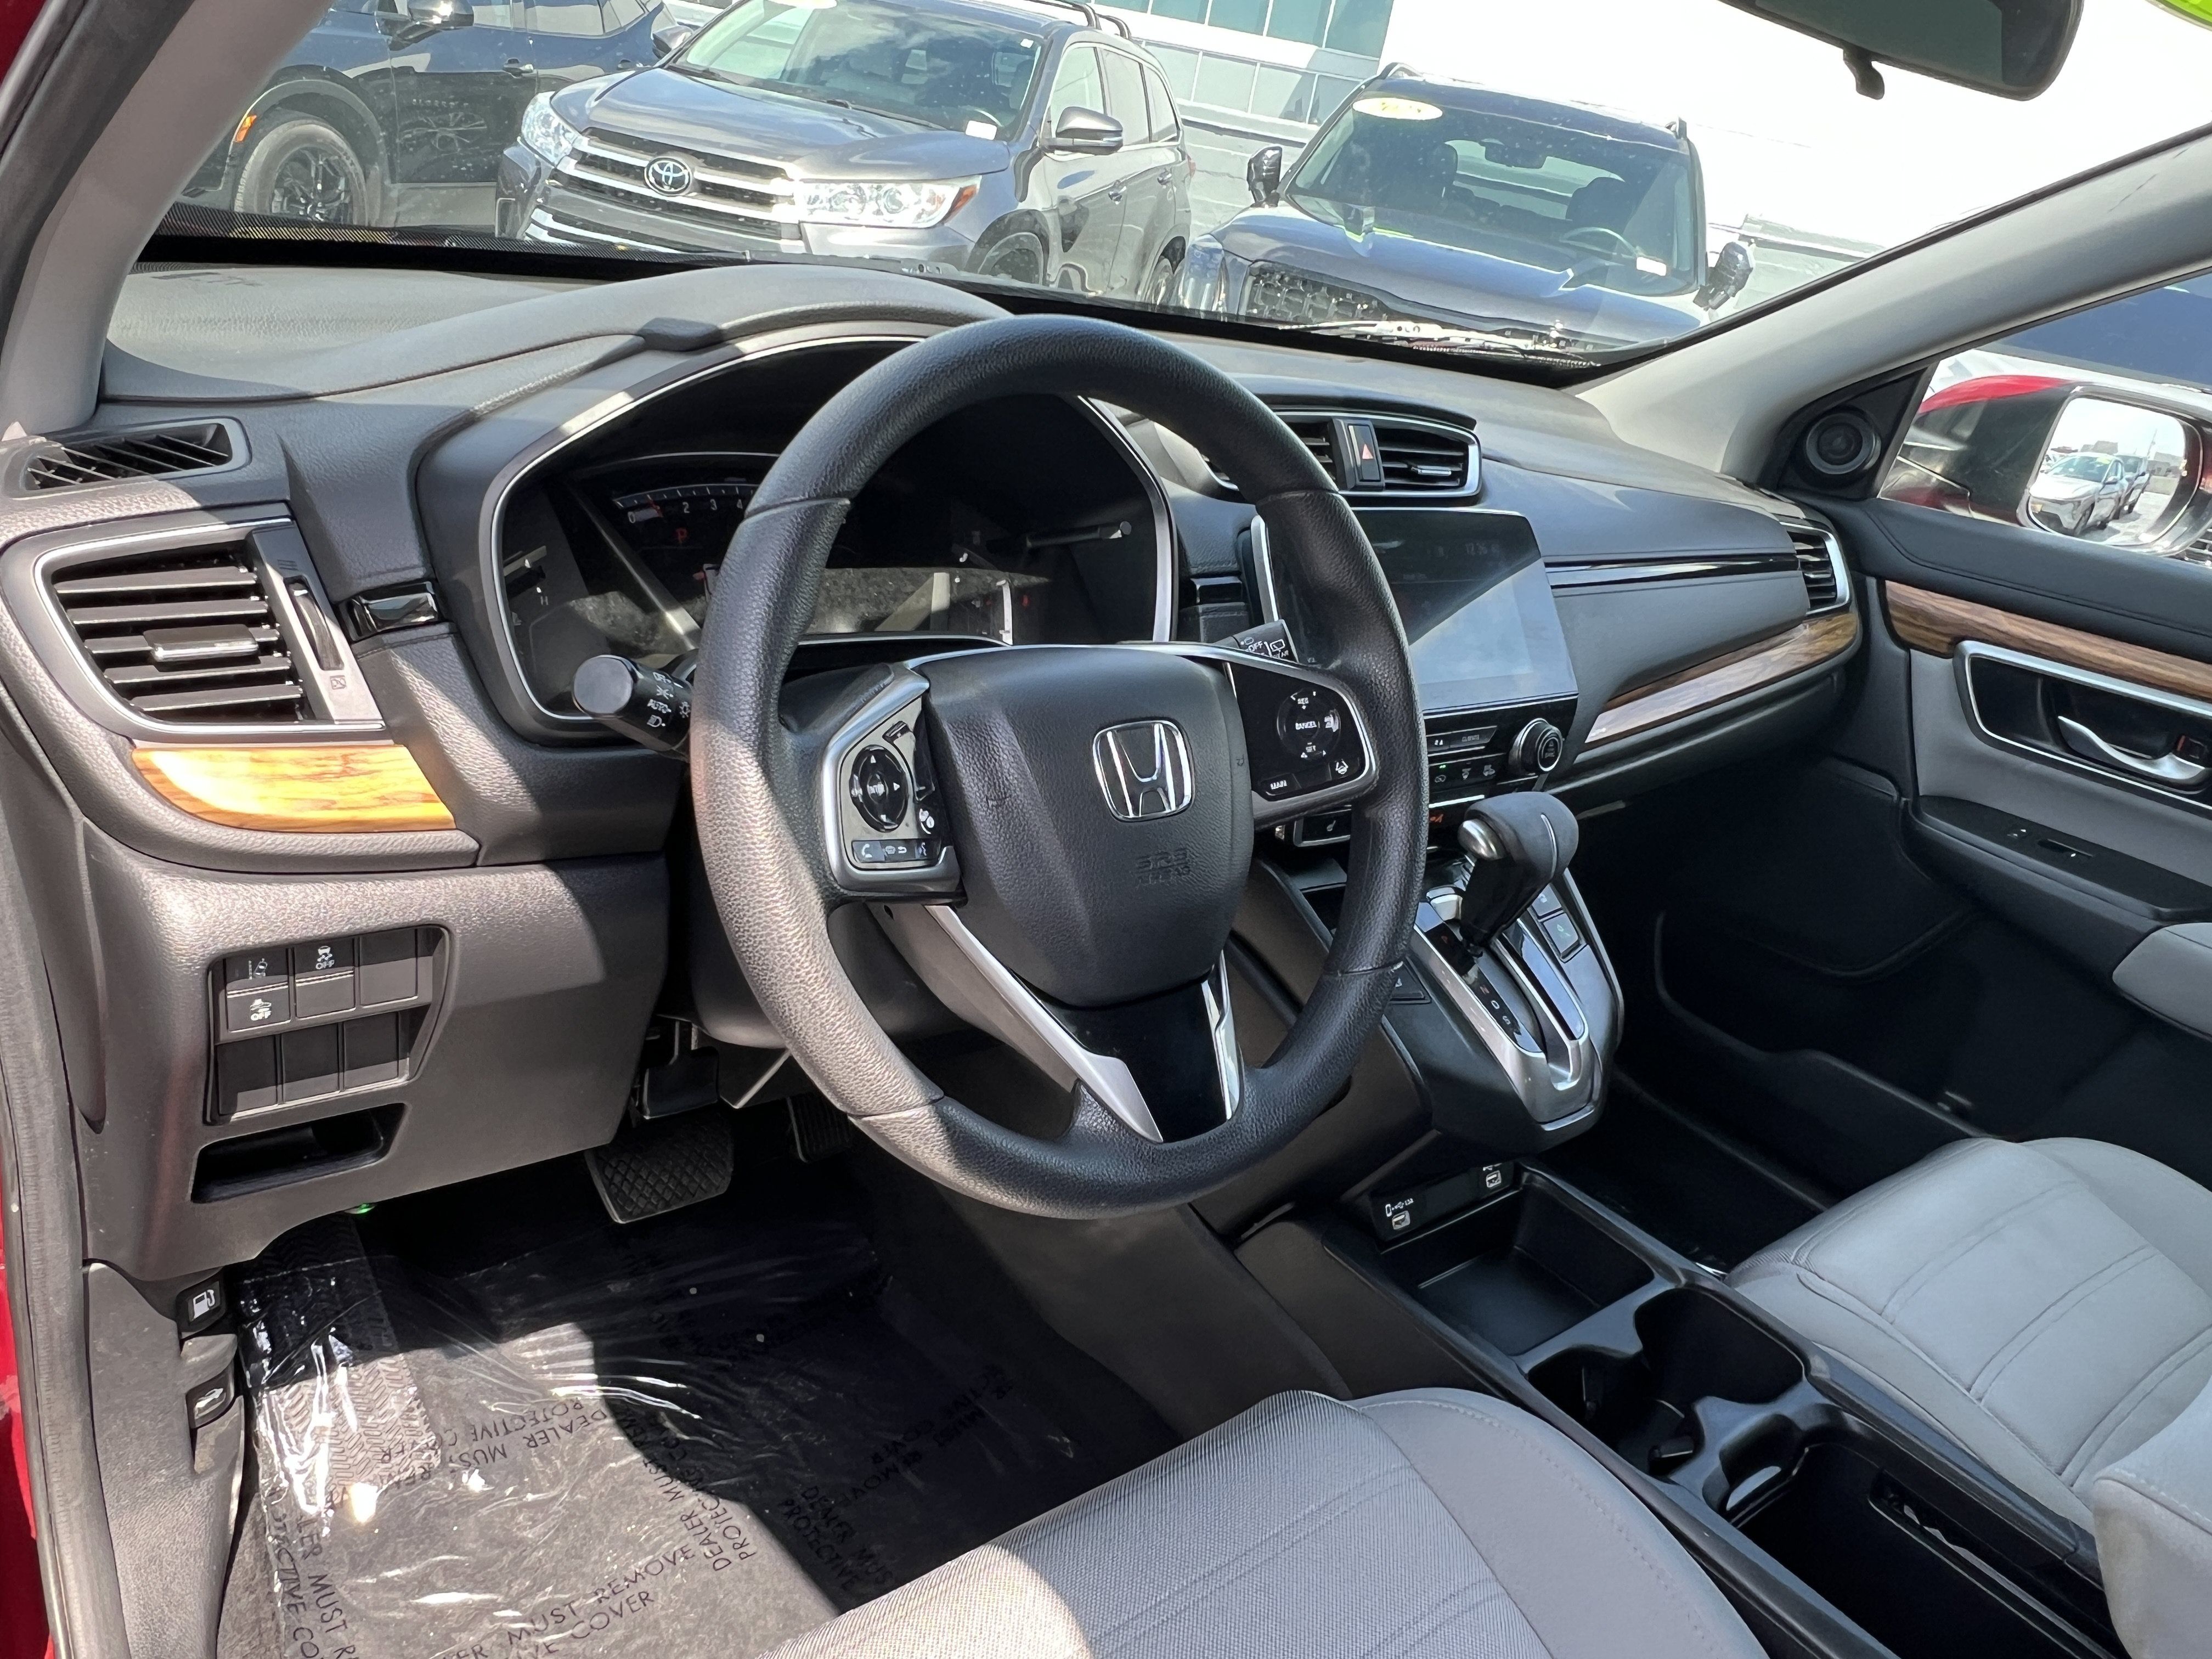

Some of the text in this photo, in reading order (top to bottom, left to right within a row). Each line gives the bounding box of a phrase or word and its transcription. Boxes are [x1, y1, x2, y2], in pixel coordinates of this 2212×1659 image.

[683, 502, 690, 514] 2
[710, 499, 718, 511] 3
[1248, 641, 1262, 652] OFF
[315, 960, 335, 970] OFF
[250, 1010, 272, 1022] OFF
[450, 1408, 607, 1468] DEALER MUS
[471, 1400, 585, 1442] ROTECTIVE
[680, 1509, 732, 1571] DEALER
[271, 1512, 307, 1615] OTECTIVE
[854, 1548, 893, 1584] MUS
[308, 1574, 348, 1633] MUST
[507, 1601, 579, 1645] MUST
[594, 1544, 696, 1604] REMOVE
[571, 1590, 656, 1639] COVER
